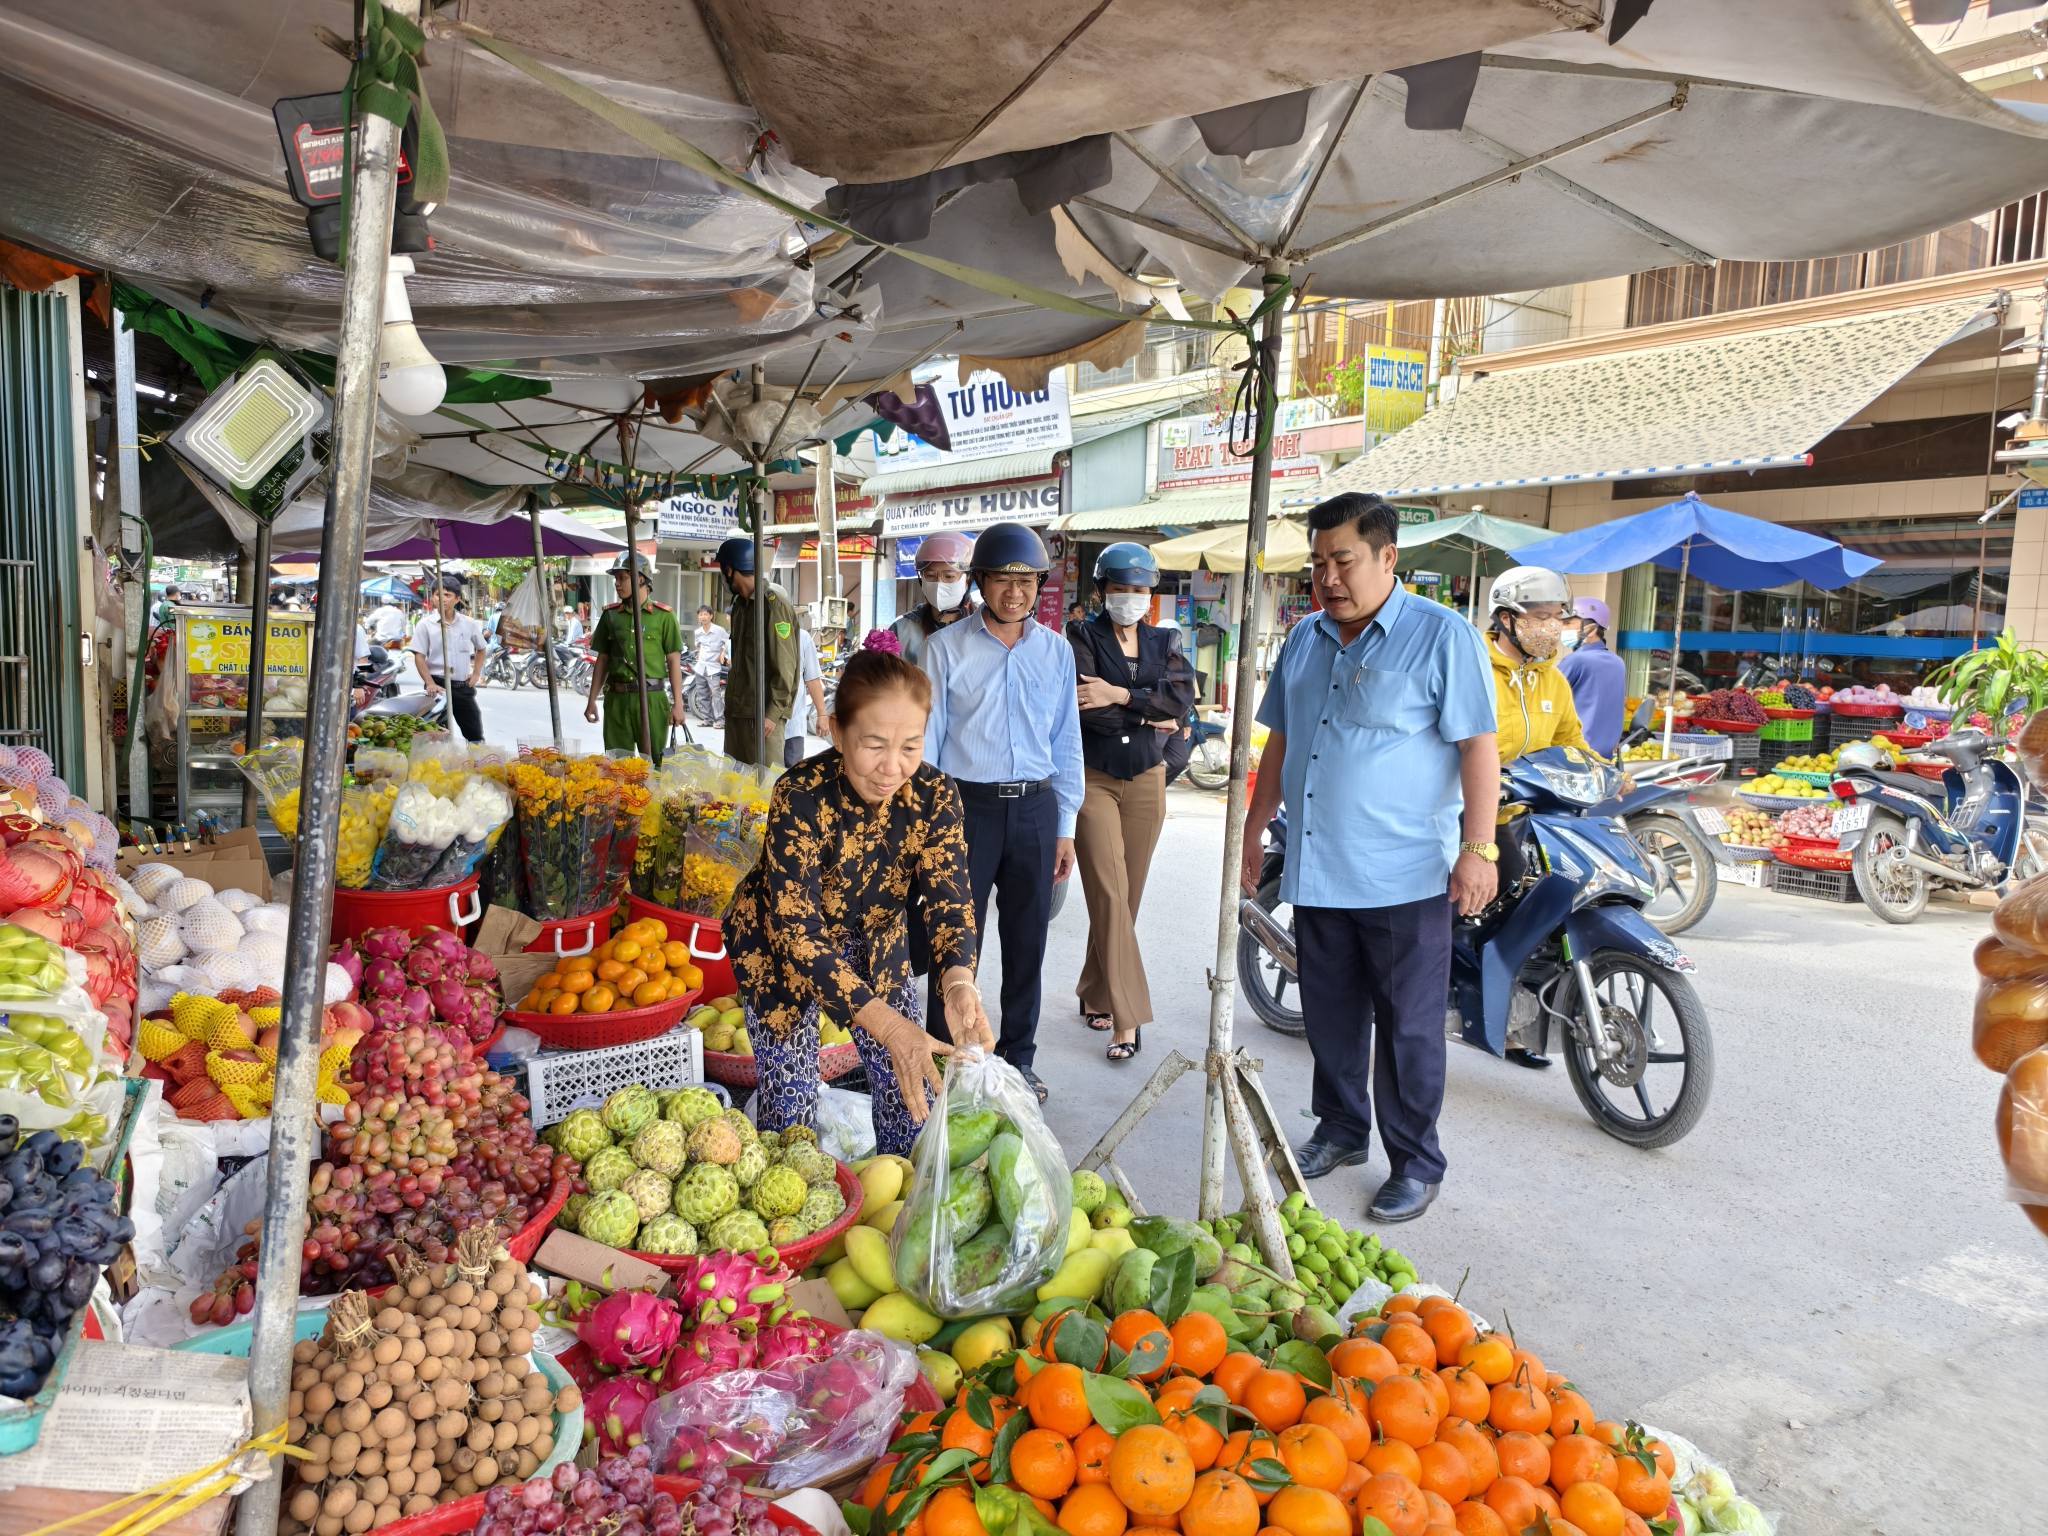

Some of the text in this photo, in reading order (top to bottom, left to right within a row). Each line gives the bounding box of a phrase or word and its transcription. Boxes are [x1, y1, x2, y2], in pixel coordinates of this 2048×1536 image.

[1397, 354, 1424, 391] SÁCH
[948, 384, 975, 420] TƯ
[259, 472, 283, 496] SOLAR
[266, 480, 289, 503] LIGHT
[671, 500, 716, 517] NGỌC
[1400, 509, 1429, 523] SÁCH
[222, 623, 301, 638] BÁN BAO
[1552, 868, 1580, 884] HONDA
